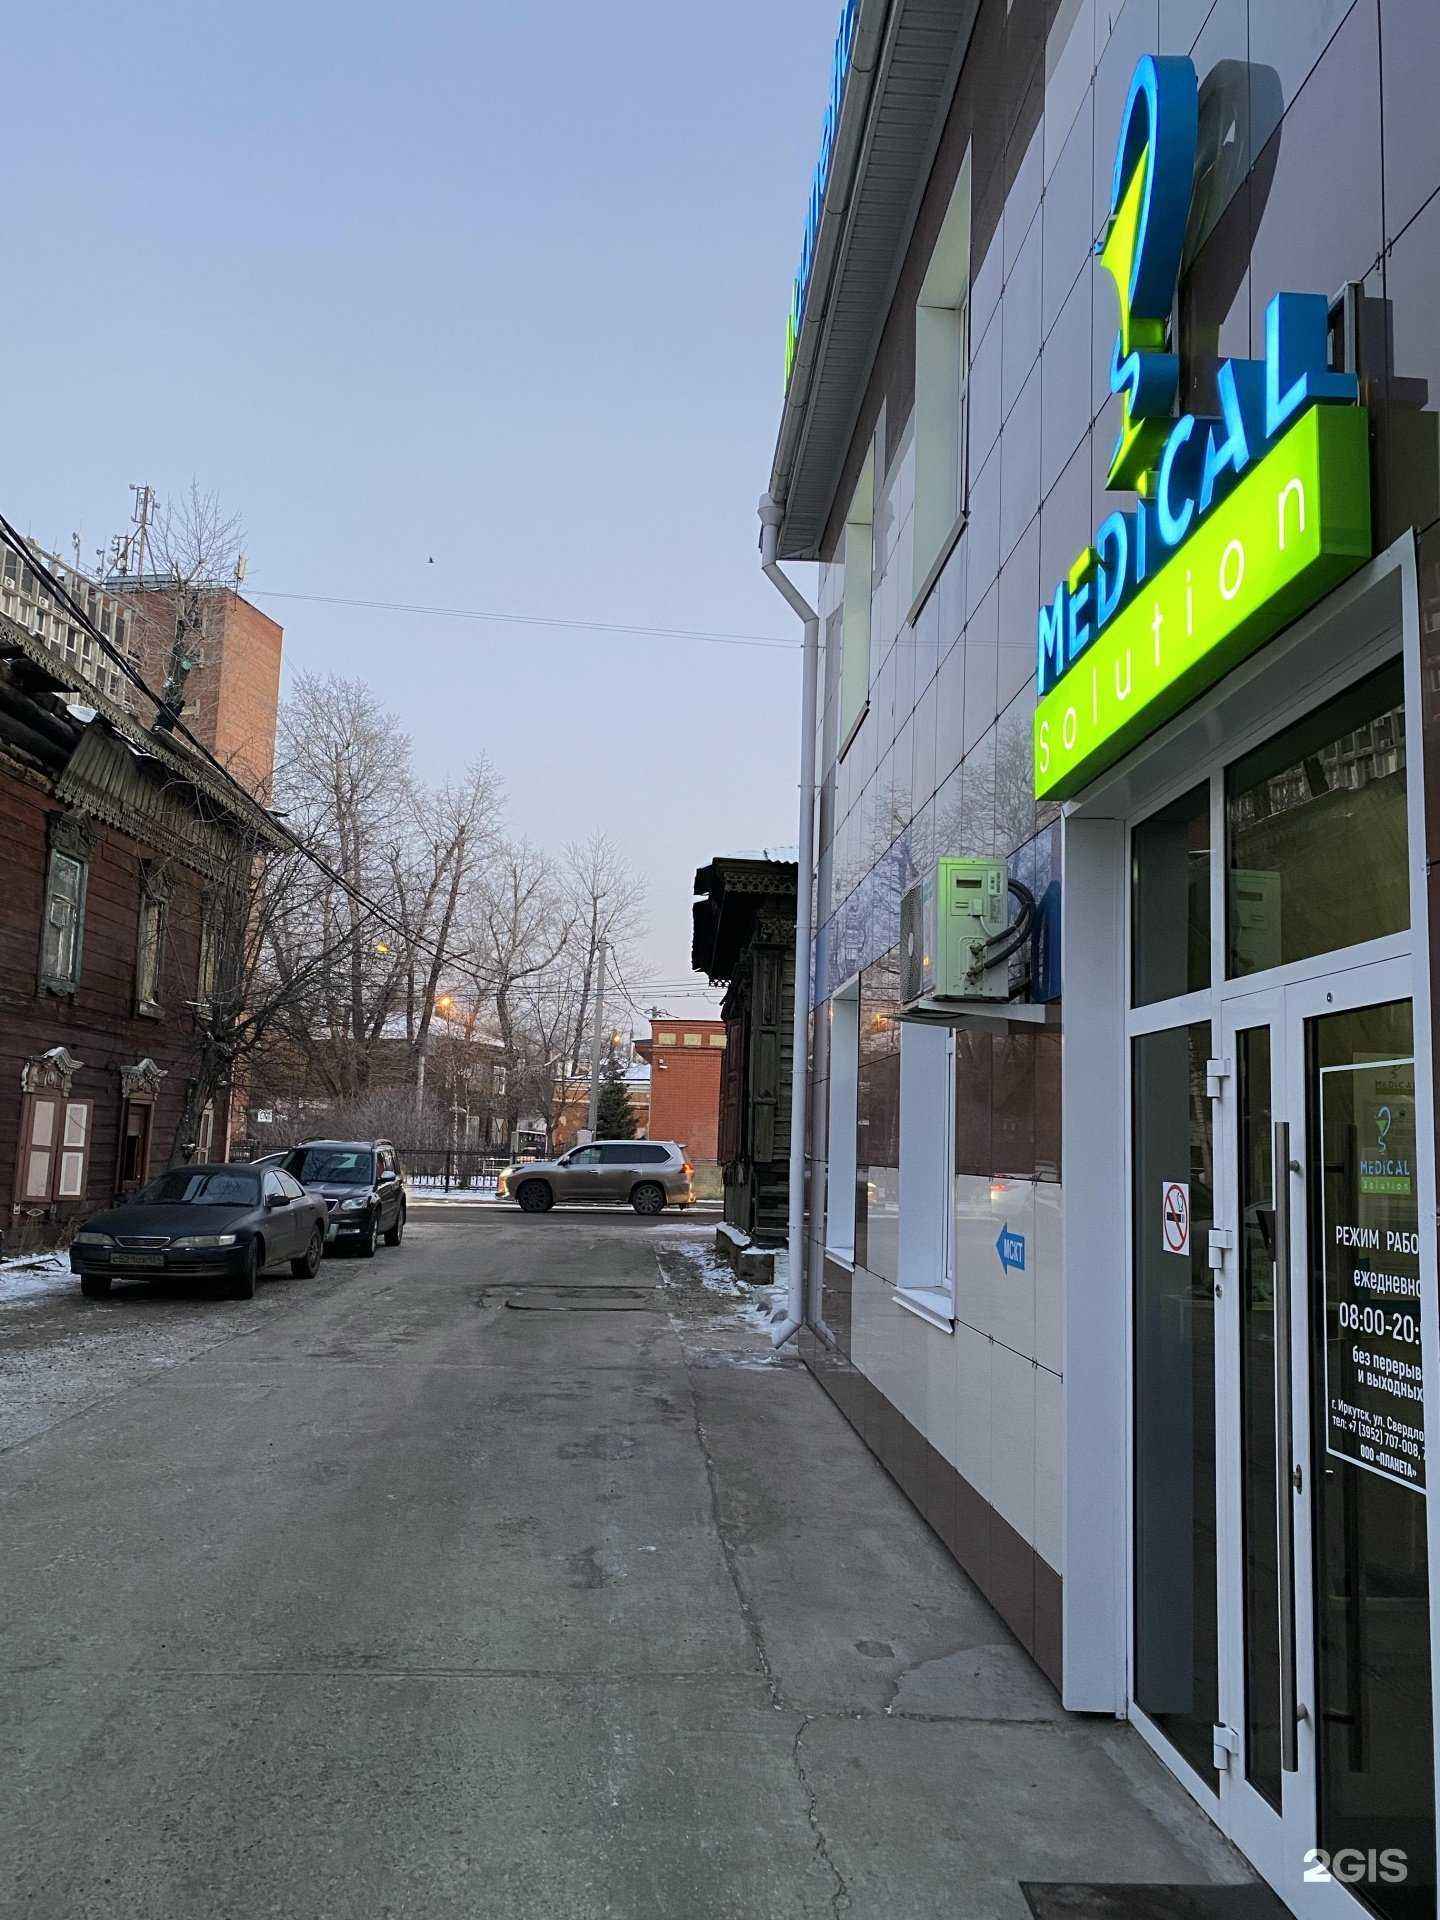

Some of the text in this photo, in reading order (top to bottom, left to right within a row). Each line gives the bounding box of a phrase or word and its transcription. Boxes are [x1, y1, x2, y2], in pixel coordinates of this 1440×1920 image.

[1335, 1225, 1380, 1250] РЕЖИМ
[1352, 1345, 1371, 1366] без
[1360, 1444, 1375, 1462] ООО
